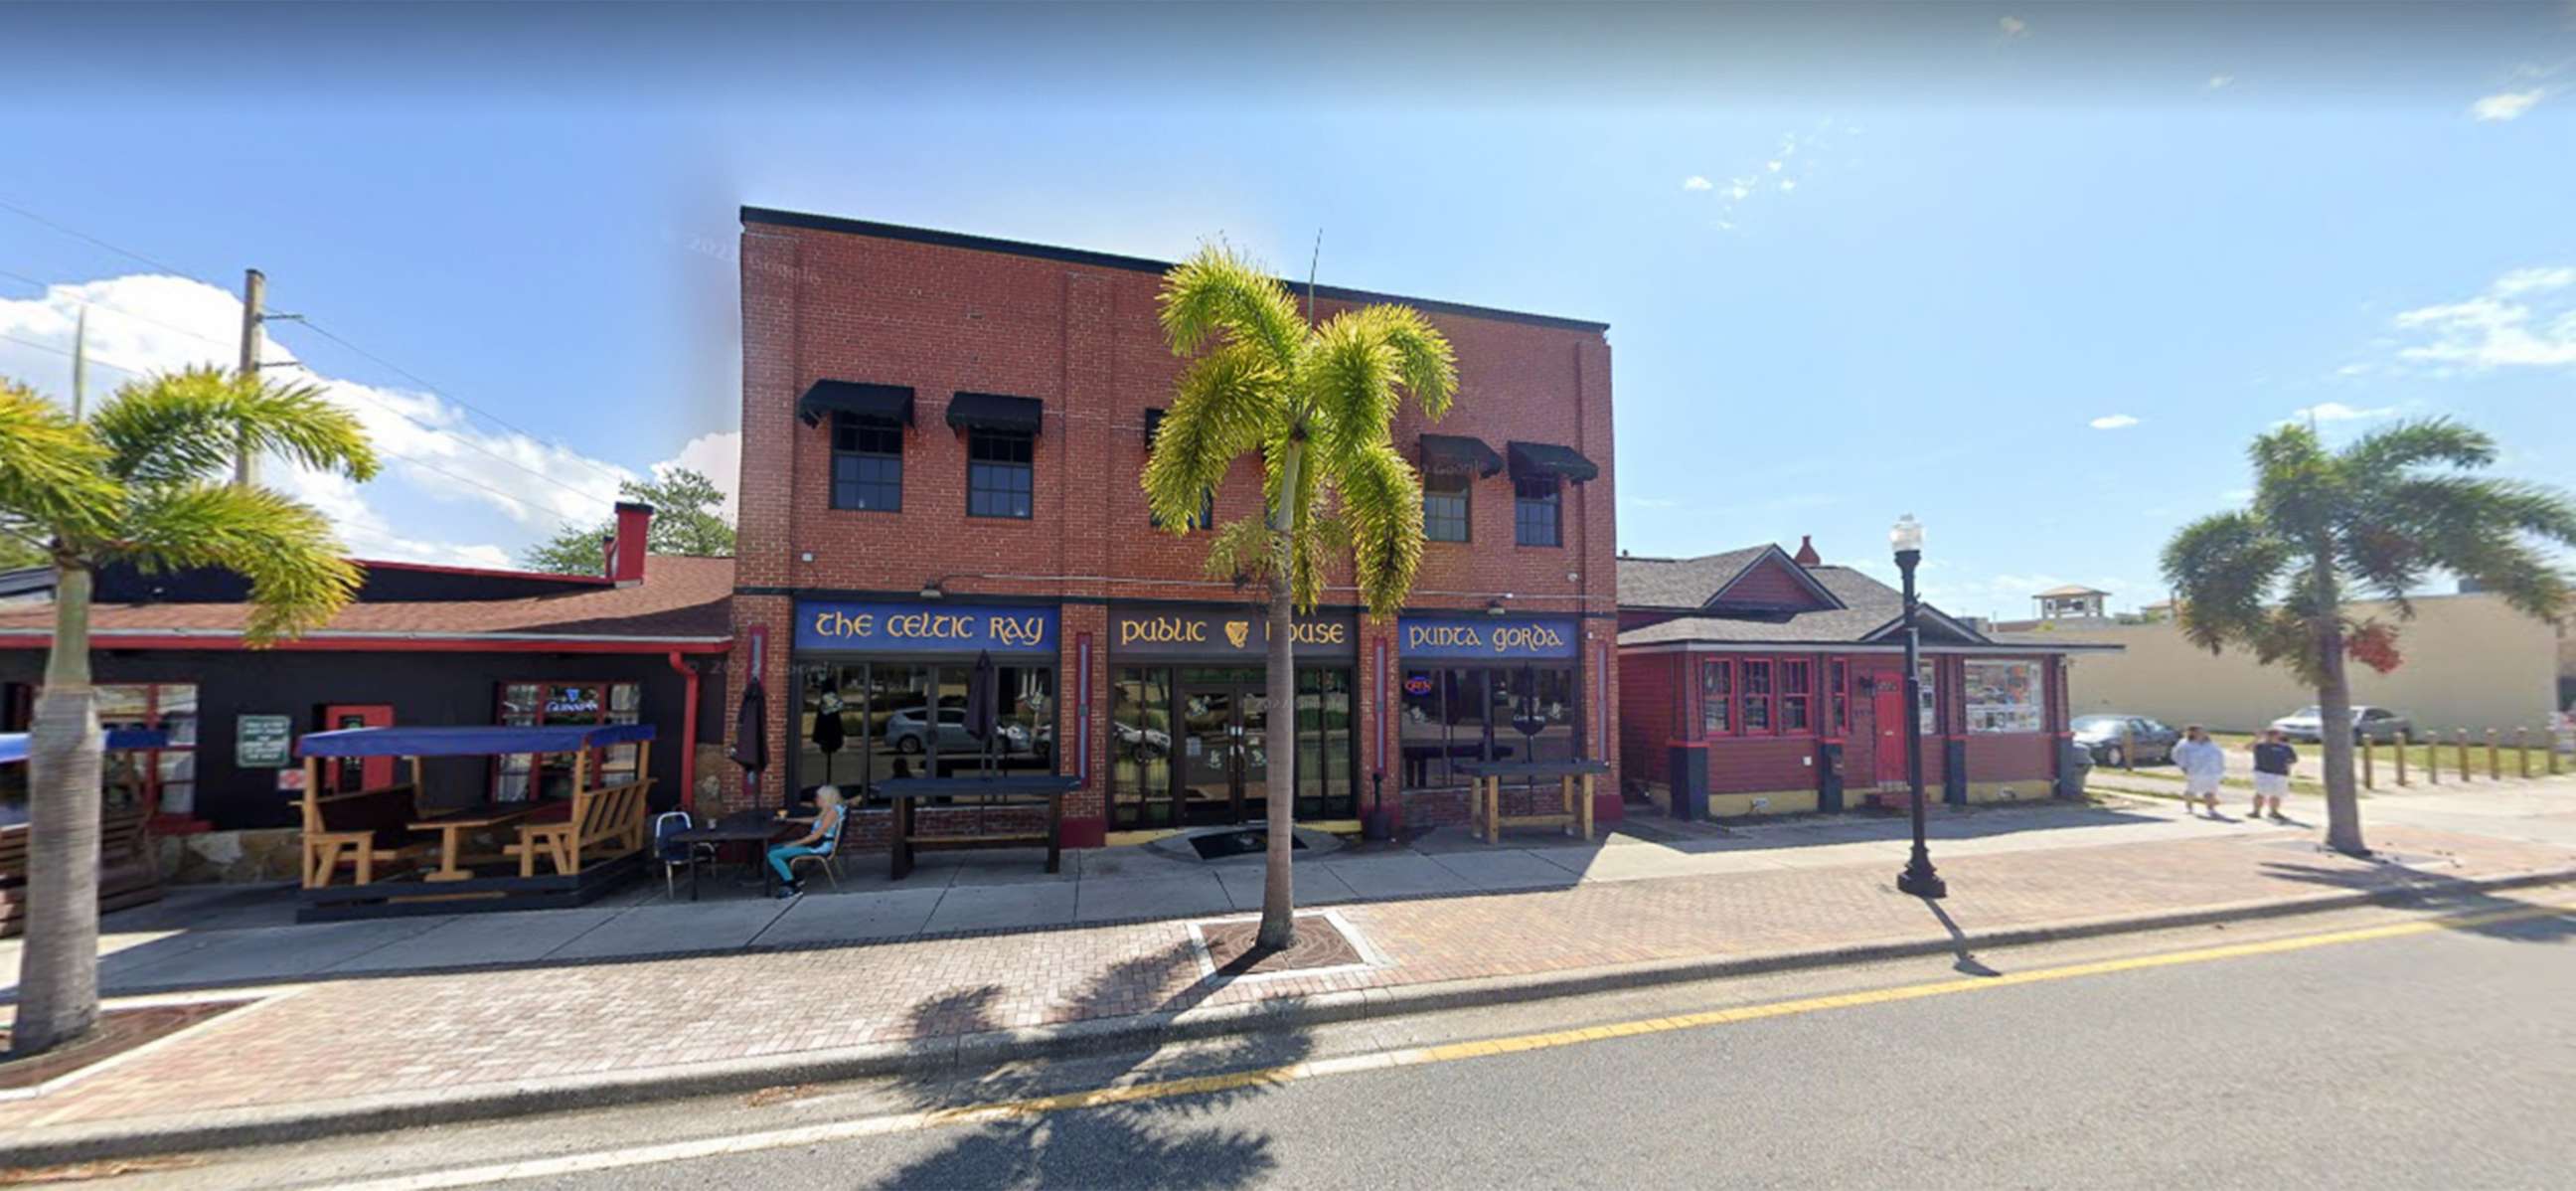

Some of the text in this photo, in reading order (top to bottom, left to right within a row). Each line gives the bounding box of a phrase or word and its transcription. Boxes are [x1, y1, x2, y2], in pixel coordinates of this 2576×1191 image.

[815, 610, 1044, 646] THE CELTIC RAY
[1121, 616, 1208, 645] PUBLIC
[1408, 623, 1564, 652] PUNTA GORDA
